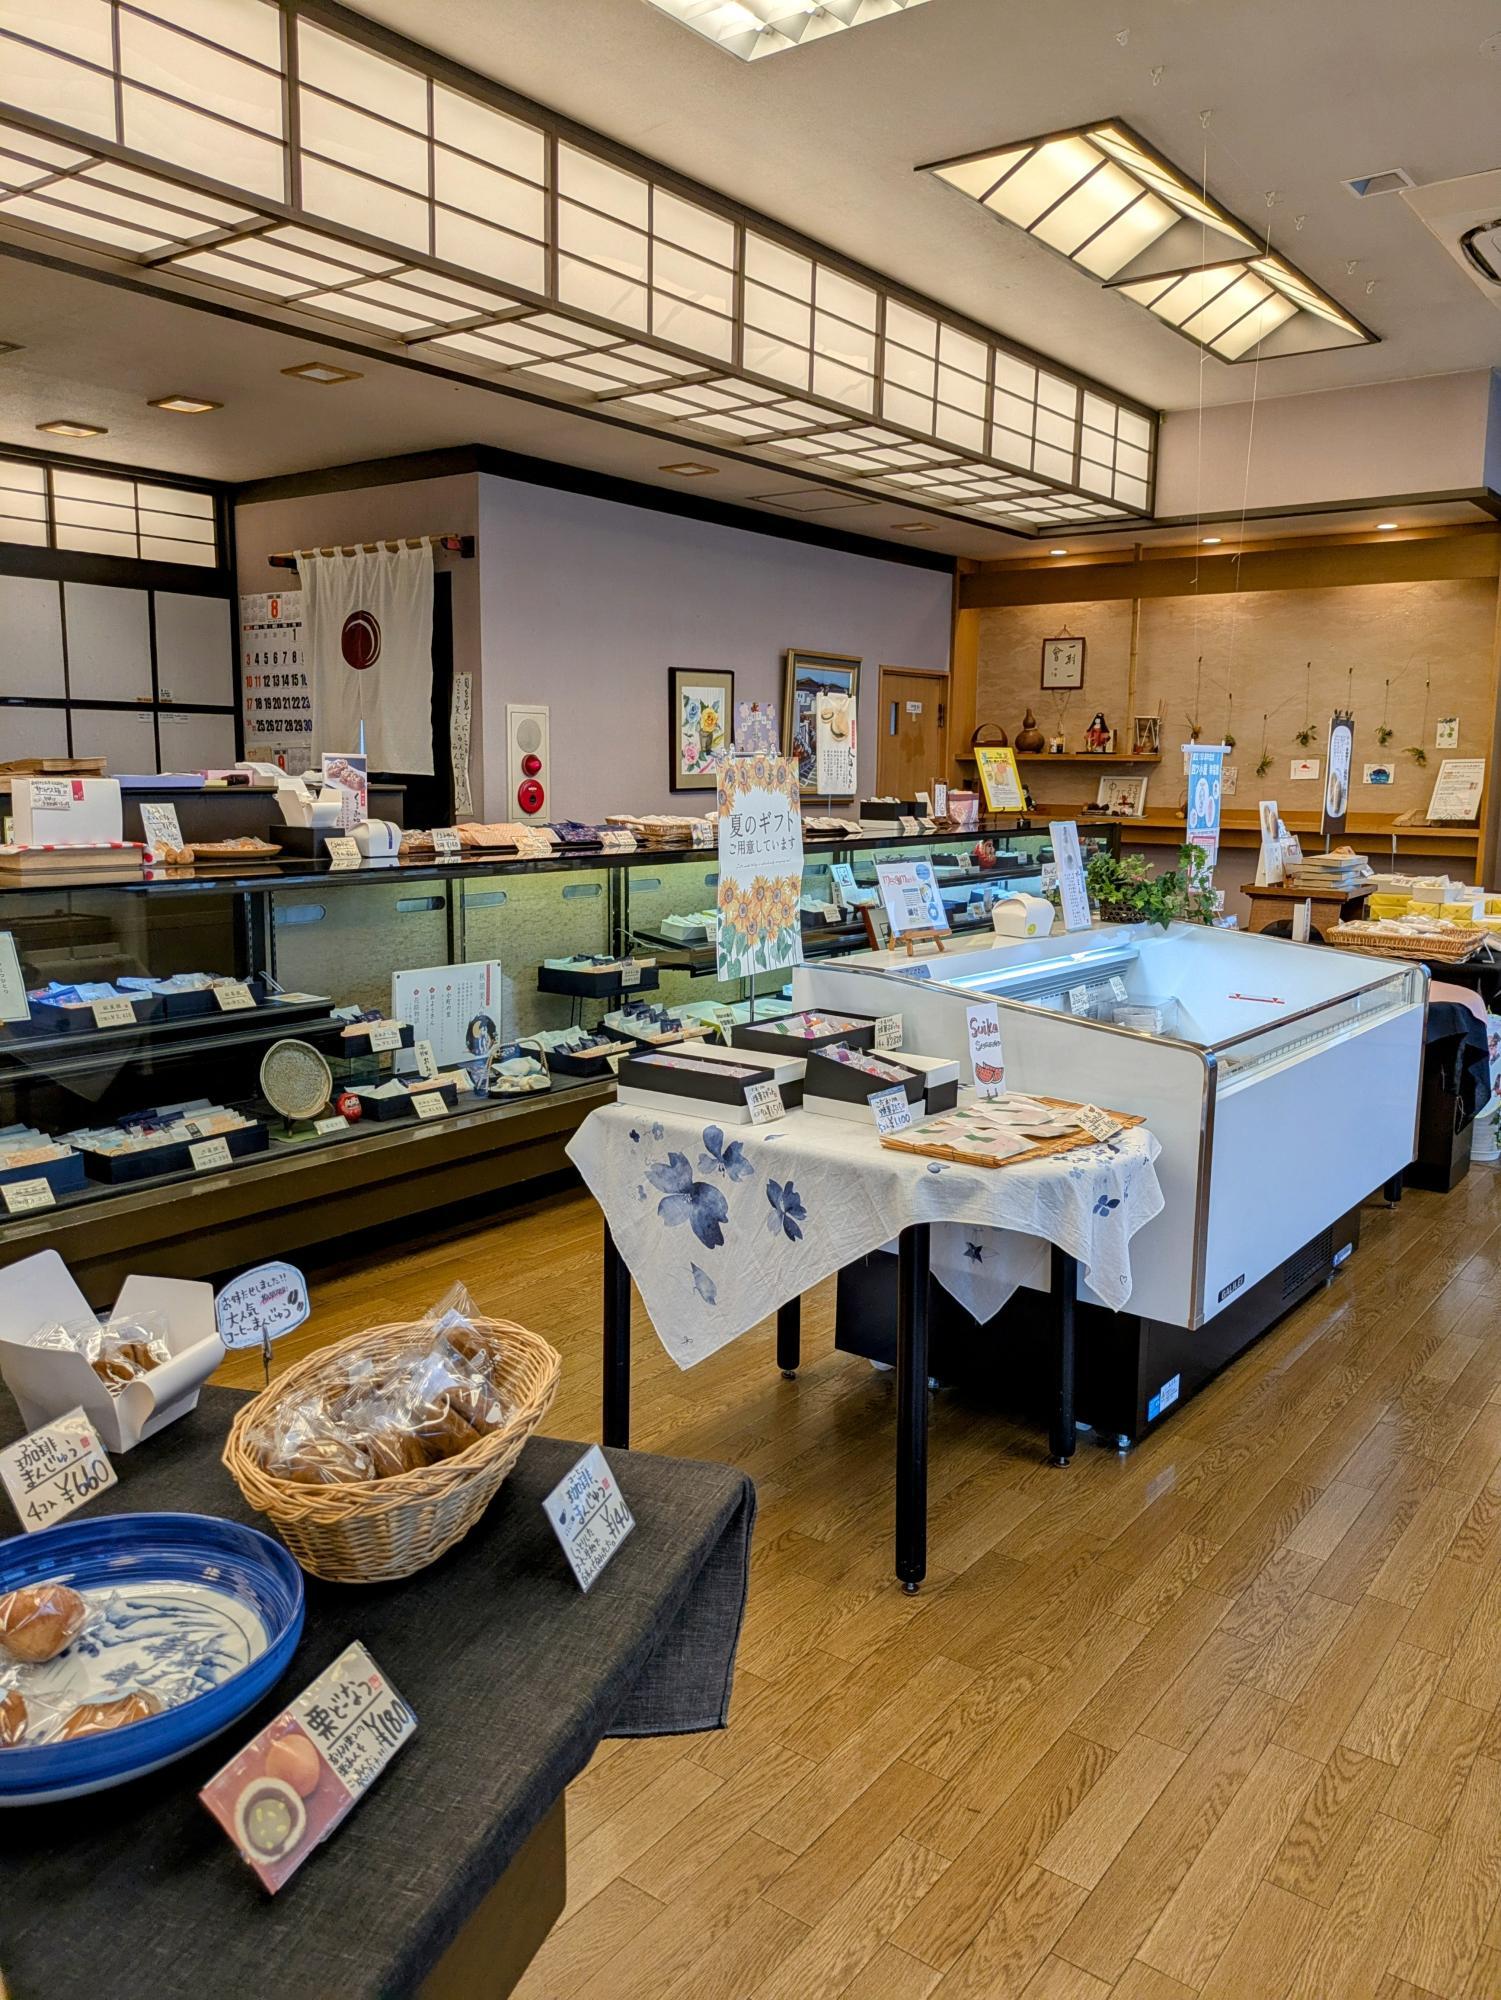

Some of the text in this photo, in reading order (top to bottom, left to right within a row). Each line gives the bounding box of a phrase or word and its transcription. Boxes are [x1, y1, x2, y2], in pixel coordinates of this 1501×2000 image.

[270, 599, 279, 619] 8
[292, 628, 298, 641] 1
[246, 651, 297, 665] 3 4 5 6 7 8
[246, 676, 253, 688] 10
[254, 675, 262, 688] 11
[263, 675, 271, 687] 12
[272, 674, 280, 687] 13
[281, 674, 290, 687] 14
[291, 674, 299, 686] 15
[246, 696, 310, 711] 17 18 19 20 21 22 23
[256, 720, 265, 732] 25
[265, 720, 275, 732] 26
[275, 720, 284, 732] 27
[284, 720, 293, 731] 28
[294, 720, 303, 731] 29
[303, 719, 312, 731] 30
[729, 810, 795, 838] 夏のギフト
[729, 836, 796, 856] ご用意しています
[1221, 1277, 1245, 1300] GALILEI
[224, 1303, 292, 1344] コーヒーまんじゅう
[225, 1302, 260, 1329] 大人気
[14, 1437, 57, 1471] 珈琲
[20, 1440, 78, 1488] まんじゅう
[53, 1459, 109, 1505] ¥660
[566, 1468, 594, 1504] 珈琲
[572, 1479, 607, 1526] まんじゅう
[599, 1500, 631, 1539] ¥140
[304, 1681, 373, 1741] 栗どーなつ
[361, 1699, 410, 1748] ¥180
